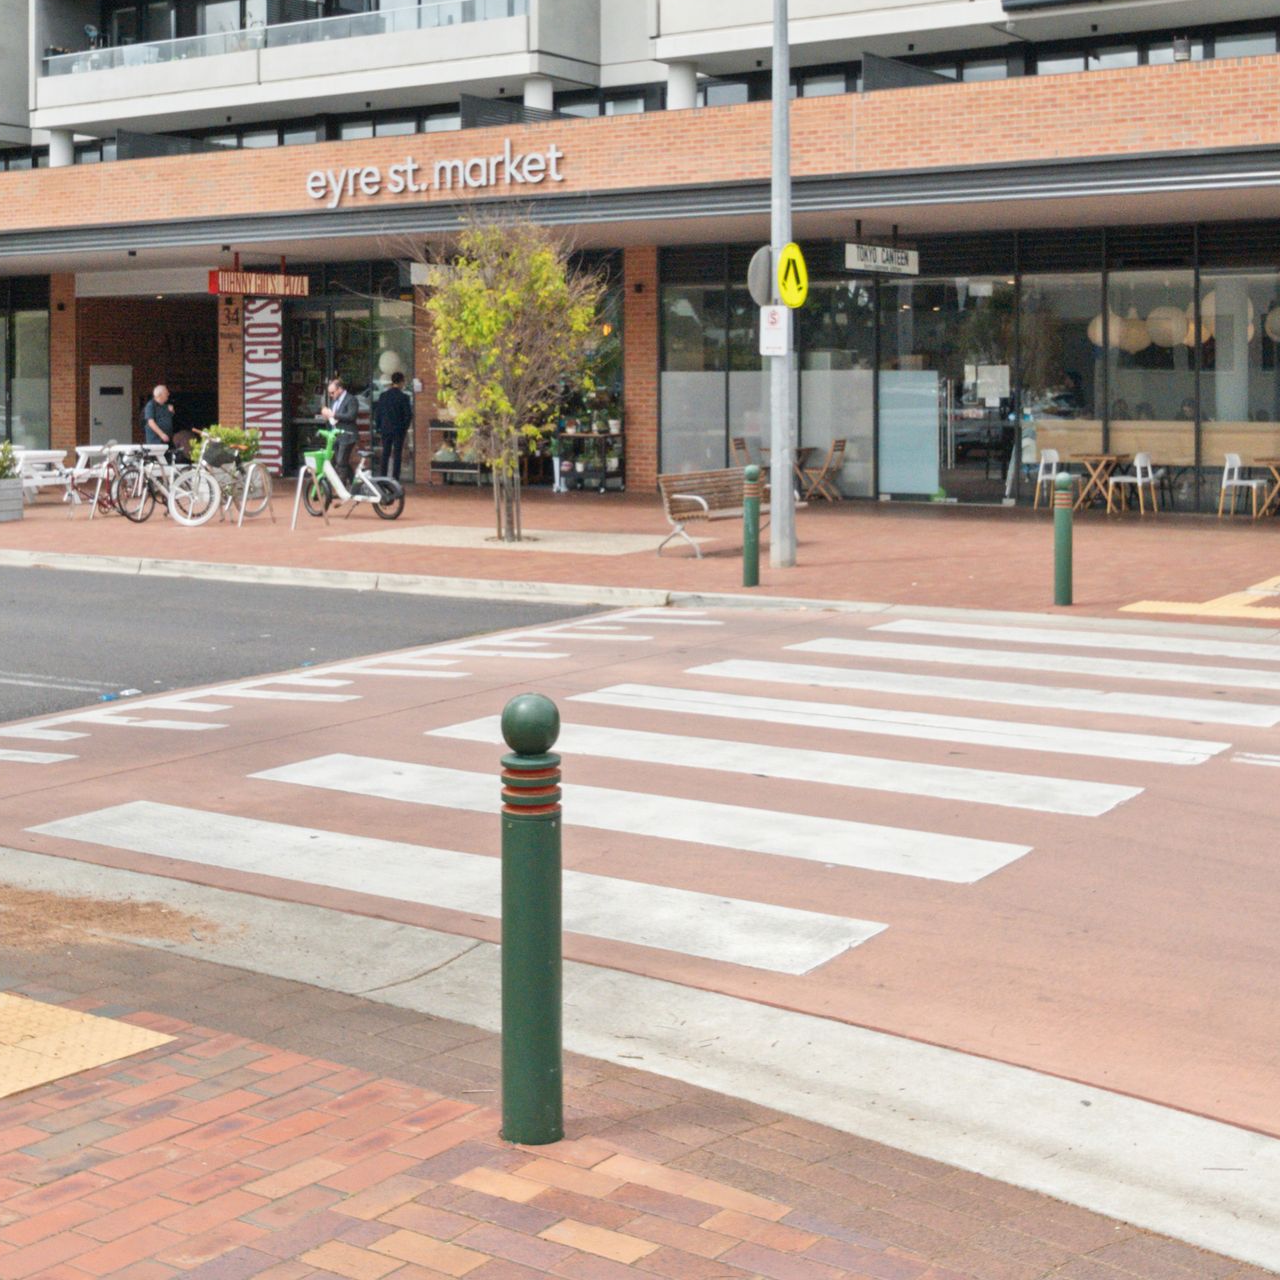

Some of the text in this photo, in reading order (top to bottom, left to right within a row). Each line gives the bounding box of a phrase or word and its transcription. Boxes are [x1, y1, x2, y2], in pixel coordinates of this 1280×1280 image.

[306, 138, 564, 208] eyre st. market
[857, 245, 909, 266] TOKYO CANTEEN
[222, 306, 240, 327] 34
[245, 298, 282, 476] JOHNNY GIO'S
